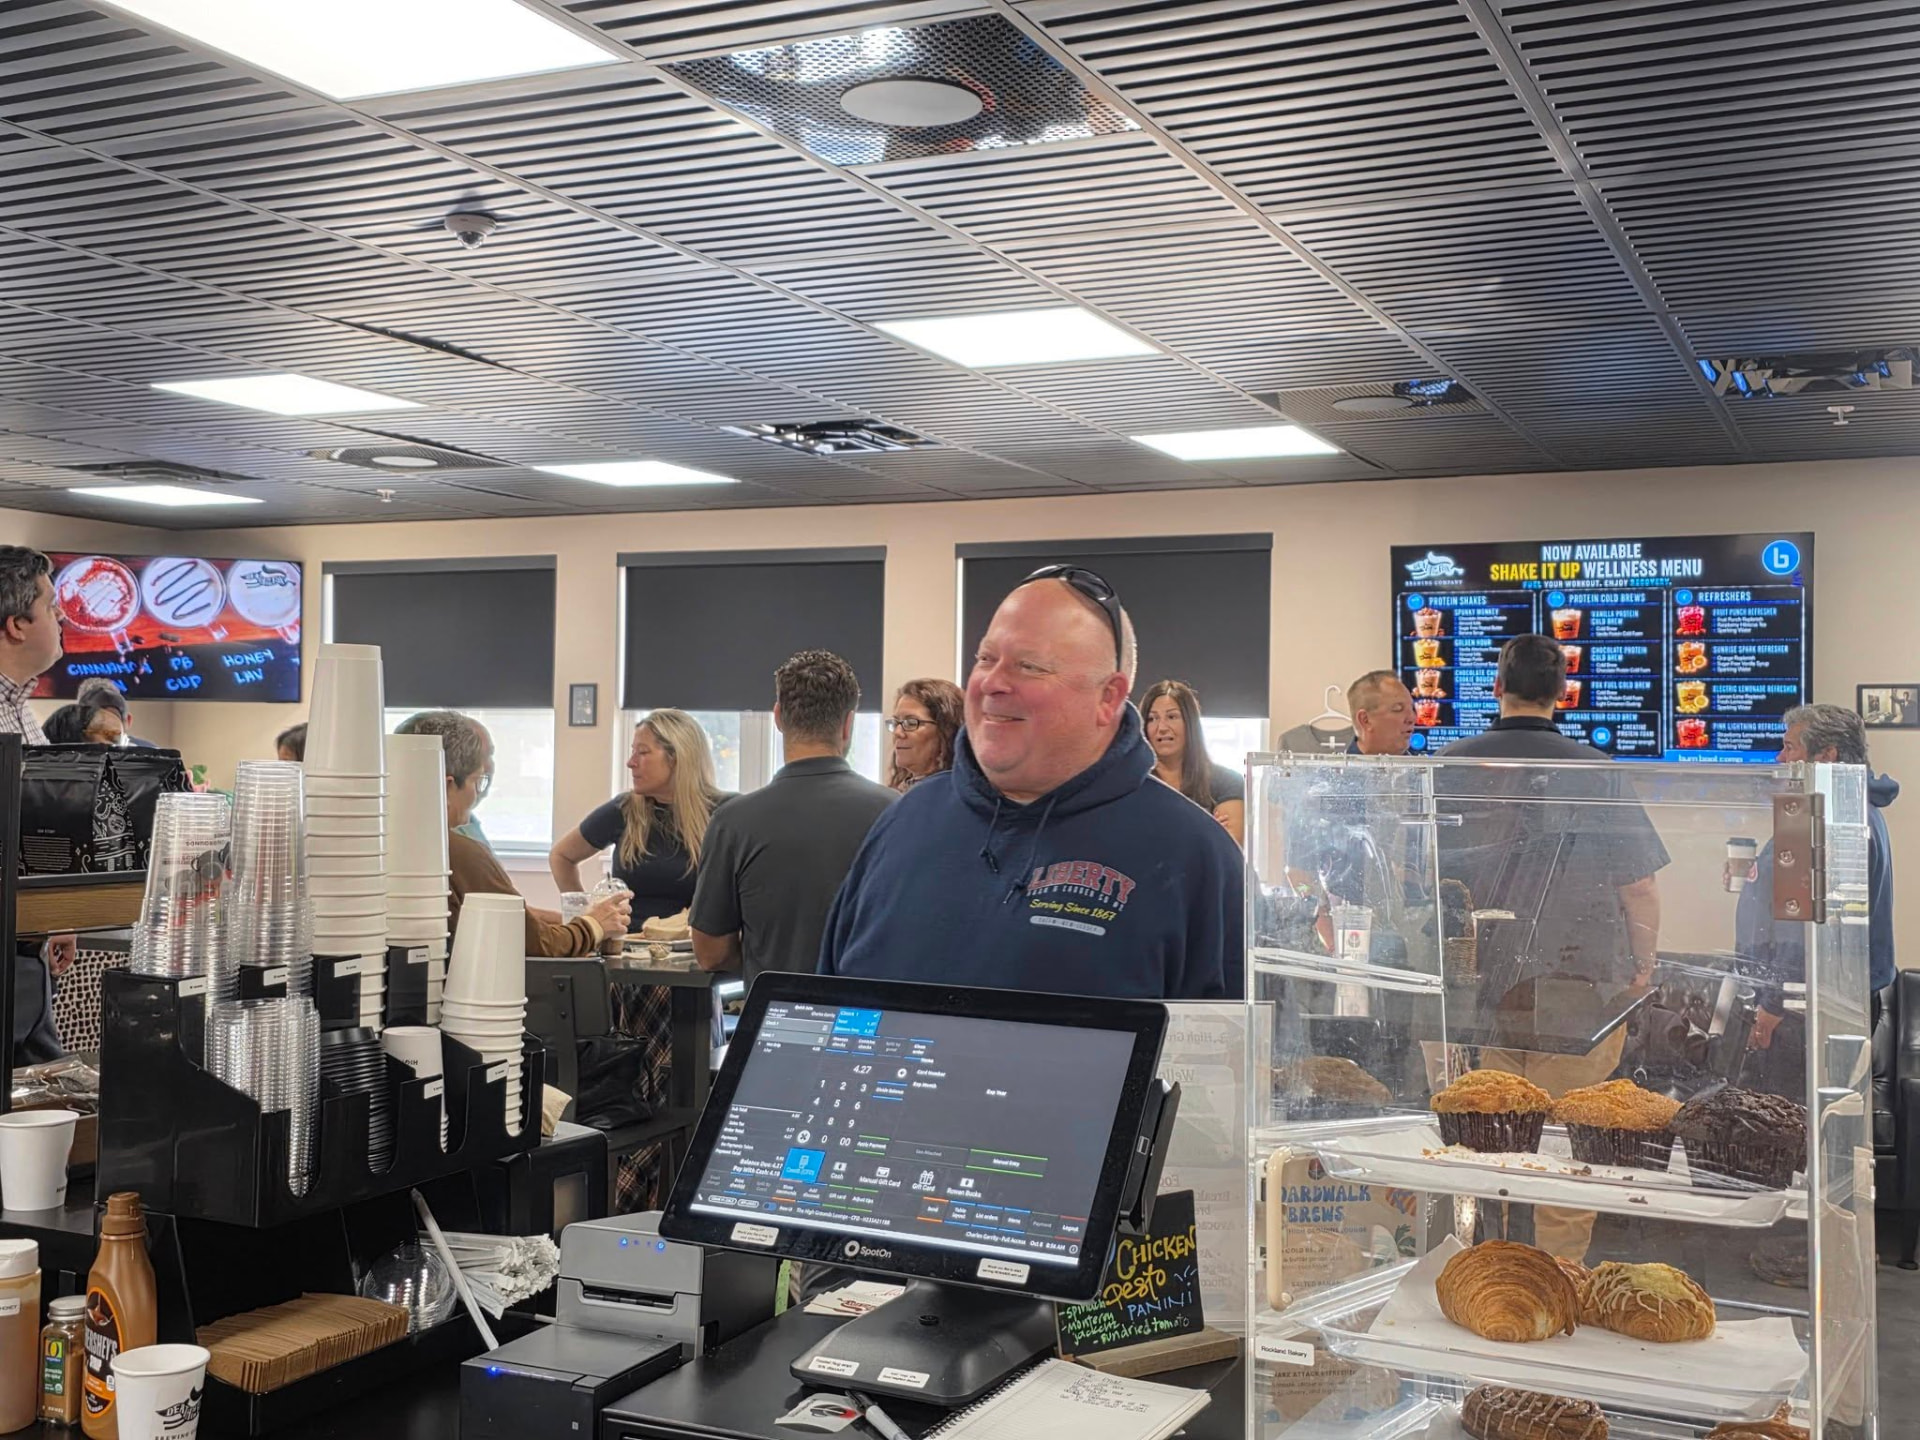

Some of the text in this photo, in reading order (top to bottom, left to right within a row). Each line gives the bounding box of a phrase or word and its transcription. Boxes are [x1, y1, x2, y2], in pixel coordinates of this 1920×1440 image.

[1542, 543, 1642, 561] NOW AVAILABLE
[1490, 558, 1703, 581] SHAKE IT UP WELLNESS MENU
[1565, 580, 1602, 588] WORKOUT.
[1604, 579, 1629, 587] ENJOY
[1429, 596, 1487, 606] PROTEIN SHAKES
[1569, 592, 1646, 603] PROTEIN COLD BREWS
[1698, 591, 1751, 602] REFRESHERS
[1748, 607, 1777, 616] REFRESHER
[1624, 646, 1647, 654] PROTEIN
[1757, 645, 1788, 653] REFRESHER
[171, 656, 194, 671] PB
[222, 649, 275, 668] HONEY
[166, 668, 264, 691] CUP LAV
[1634, 681, 1651, 689] BREW
[1713, 685, 1797, 693] ELECTRIC LEMONADE REFRESHER
[1027, 860, 1136, 904] LIBERTY
[1029, 899, 1117, 922] Serving Since 1867
[853, 1065, 872, 1074] 4.27
[820, 1080, 867, 1092] 1 2 3
[813, 1097, 861, 1110] 4 5 6
[807, 1114, 855, 1128] 7 8 9
[821, 1134, 851, 1146] 0 00
[740, 1159, 760, 1167] Balance
[859, 1177, 878, 1185] Manual
[879, 1178, 889, 1186] Gift
[912, 1182, 936, 1192] Gift Card
[966, 1190, 982, 1198] Bucks
[1281, 1184, 1371, 1203] OARDWALK
[1288, 1206, 1345, 1223] BREWS
[860, 1245, 892, 1258] SpotOn
[1261, 1345, 1308, 1358] Rockland Bakery
